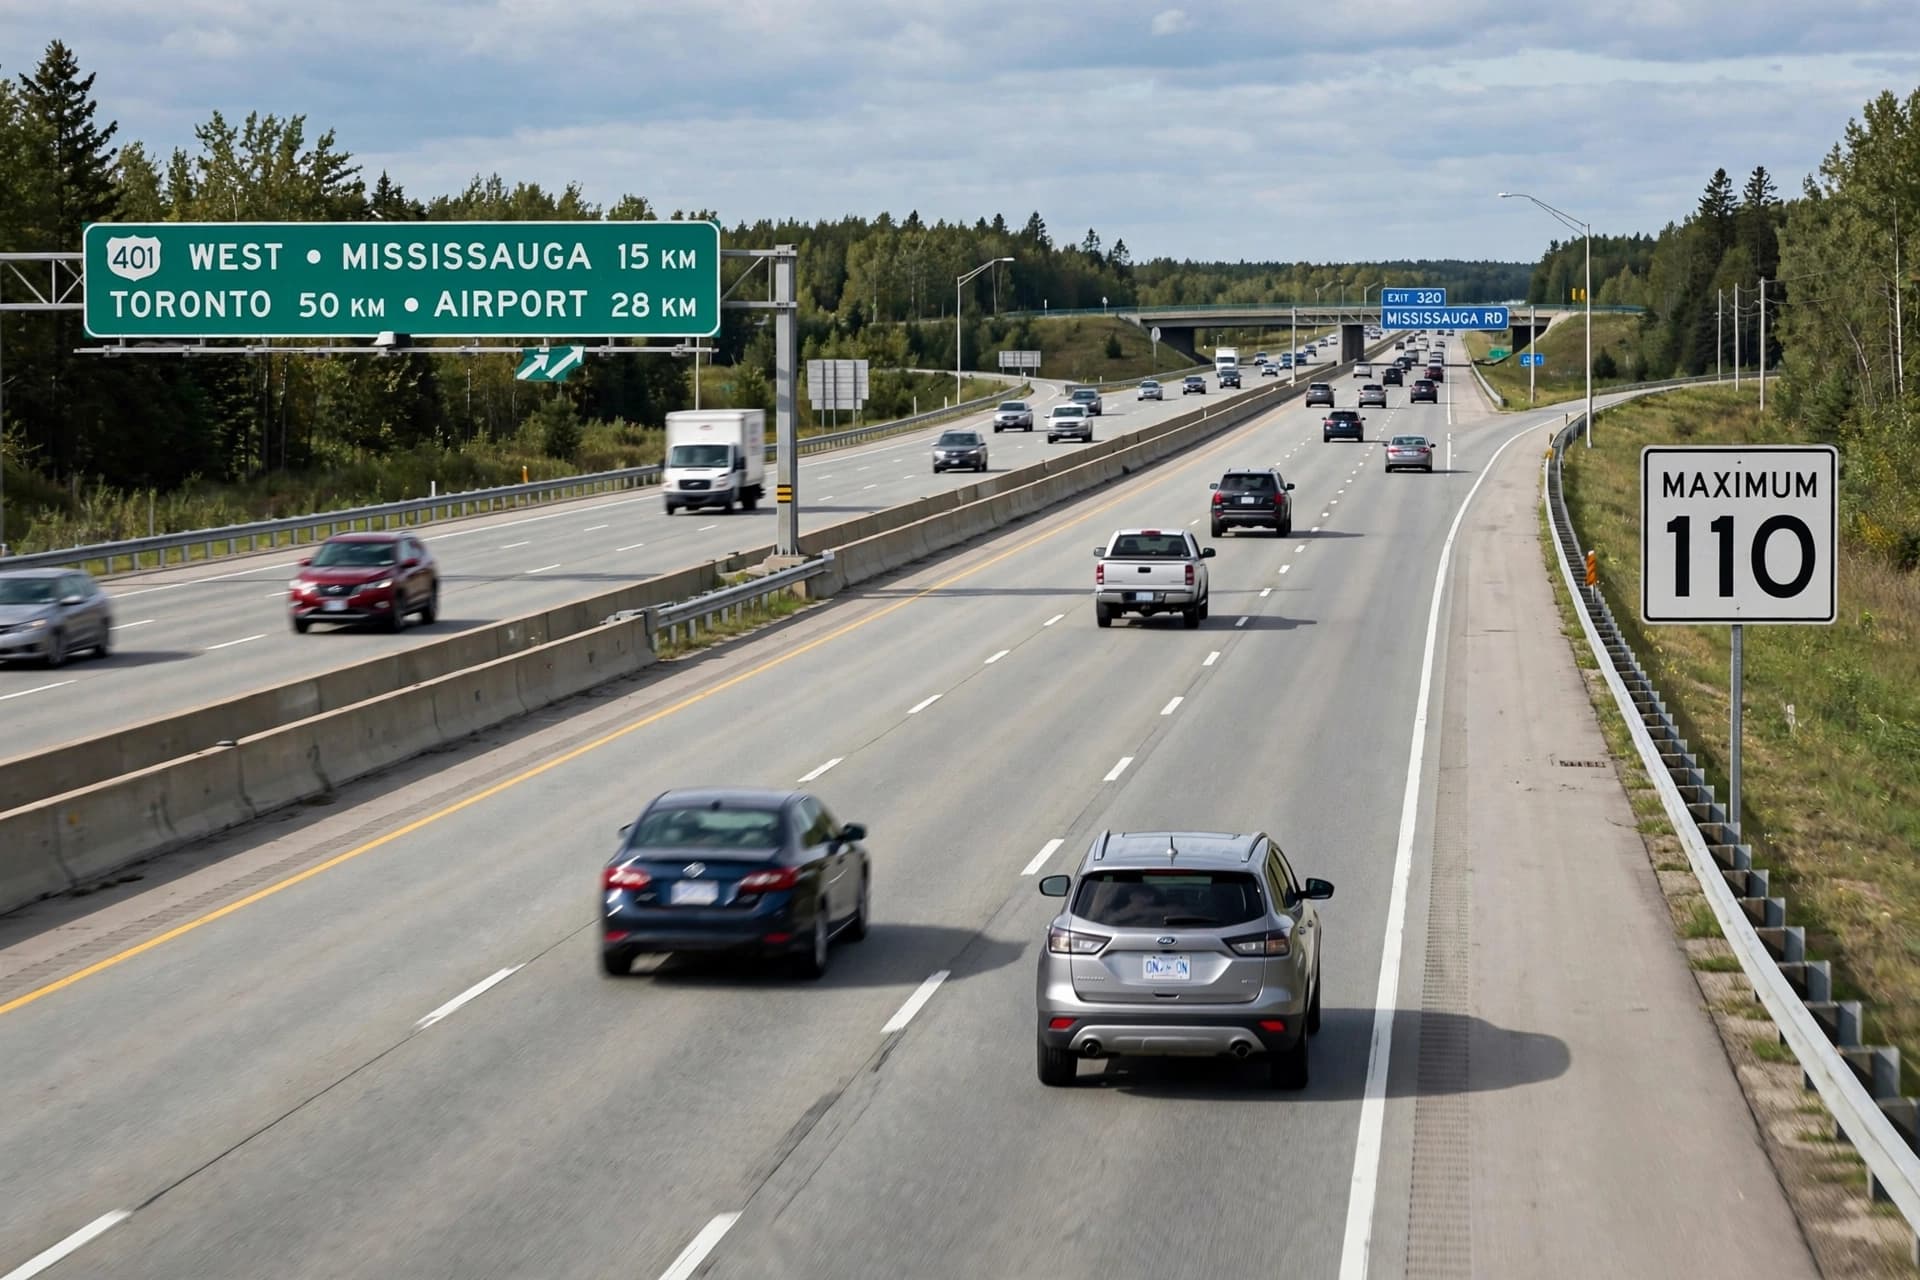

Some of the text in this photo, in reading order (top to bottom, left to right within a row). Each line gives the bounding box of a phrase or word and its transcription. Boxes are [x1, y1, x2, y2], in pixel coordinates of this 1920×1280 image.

[112, 242, 697, 271] 401 WEST MISSISSAUGA 15 KM
[109, 289, 697, 318] TORONTO 50 KM AIRPORT 28 KM
[1387, 292, 1442, 304] EXIT 320
[1387, 312, 1503, 325] MISSISSAUGA RD
[1663, 471, 1817, 498] MAXIMUM
[1666, 514, 1816, 599] 110
